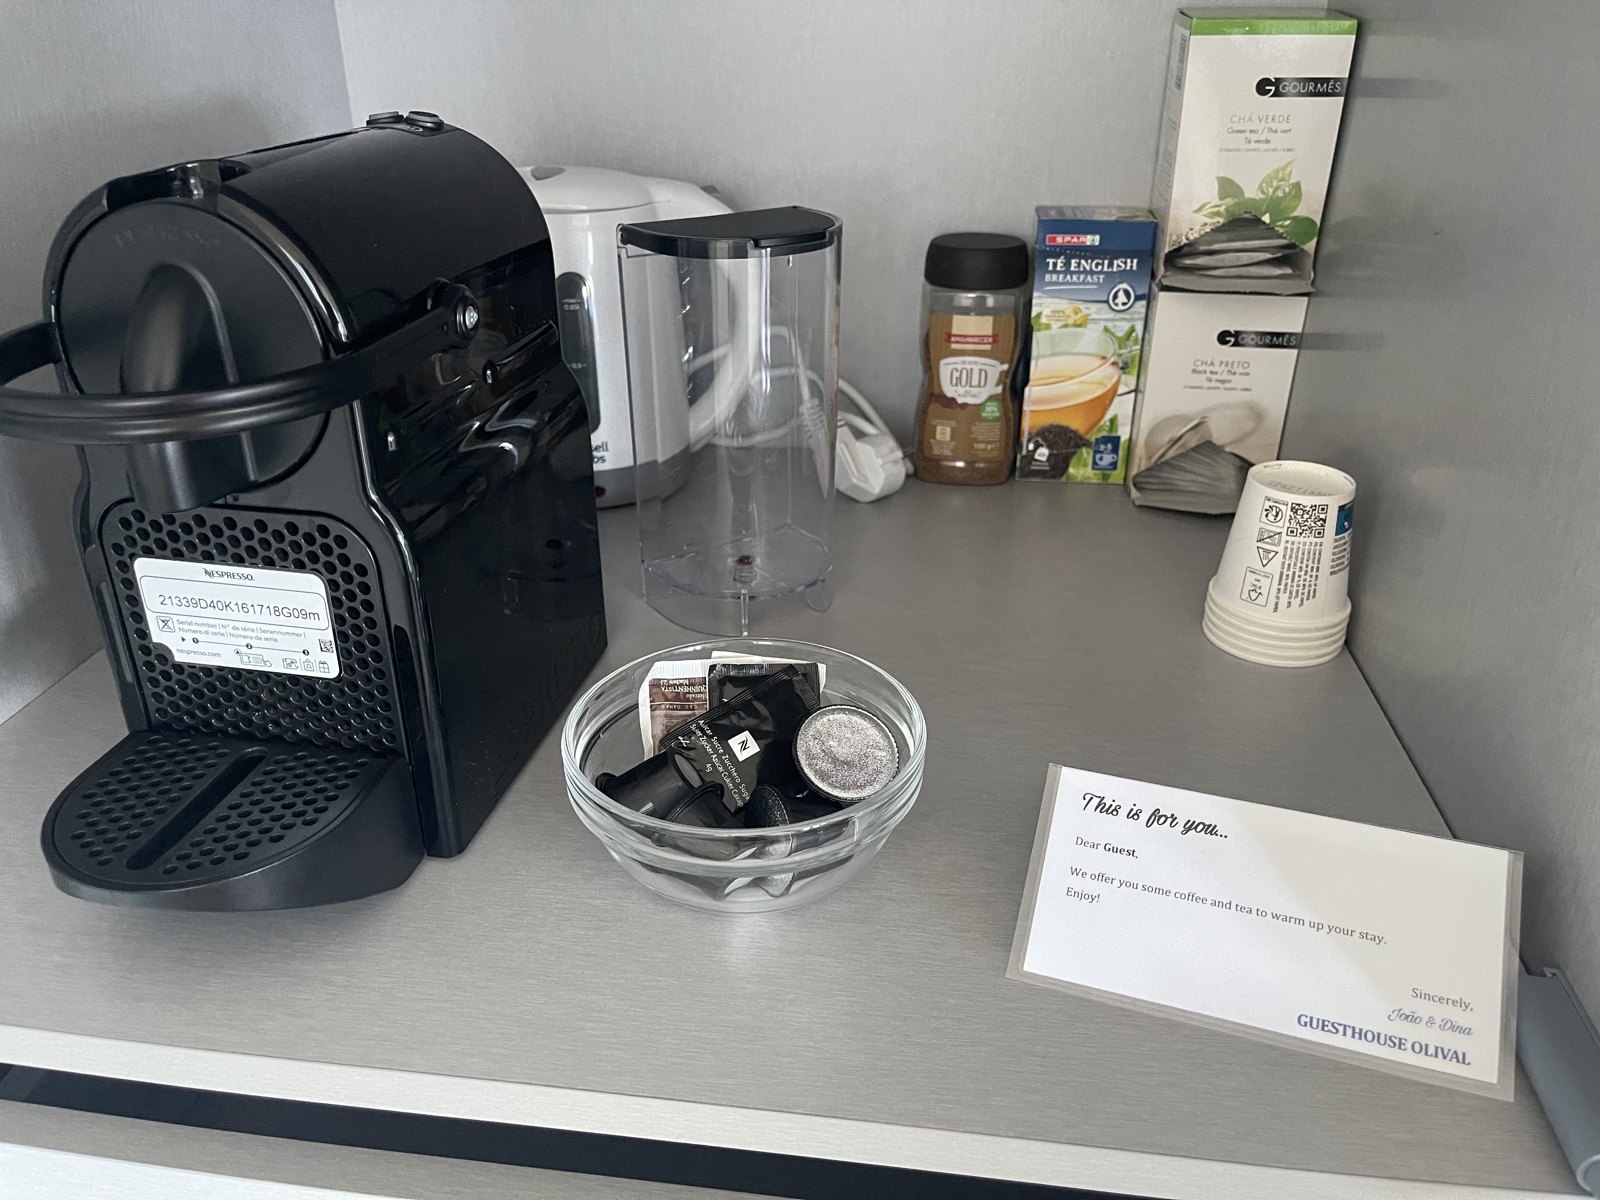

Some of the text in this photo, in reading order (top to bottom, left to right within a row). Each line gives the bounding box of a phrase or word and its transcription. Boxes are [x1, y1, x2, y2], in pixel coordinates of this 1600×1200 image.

[1258, 115, 1291, 124] VERDE
[1046, 256, 1138, 272] TÉ ENGLISH
[1044, 273, 1105, 283] BREAKFAST
[1219, 360, 1250, 370] PRETO
[950, 368, 988, 388] GOLD
[158, 594, 321, 621] 21339D40K161718G09m
[711, 736, 724, 754] Sucre
[722, 754, 740, 783] Zucchero
[739, 783, 750, 800] Suga
[1083, 792, 1228, 838] This is for you...
[1075, 836, 1139, 859] Dear Guest,
[1066, 886, 1100, 904] Enjoy!
[1070, 866, 1387, 945] We offer you some coffee and tea to warm up your stay.
[1411, 987, 1474, 1012] Sincerely,
[1387, 1008, 1474, 1036] João & Dina
[1297, 1014, 1471, 1066] GUESTHOUSE OLIVAL
